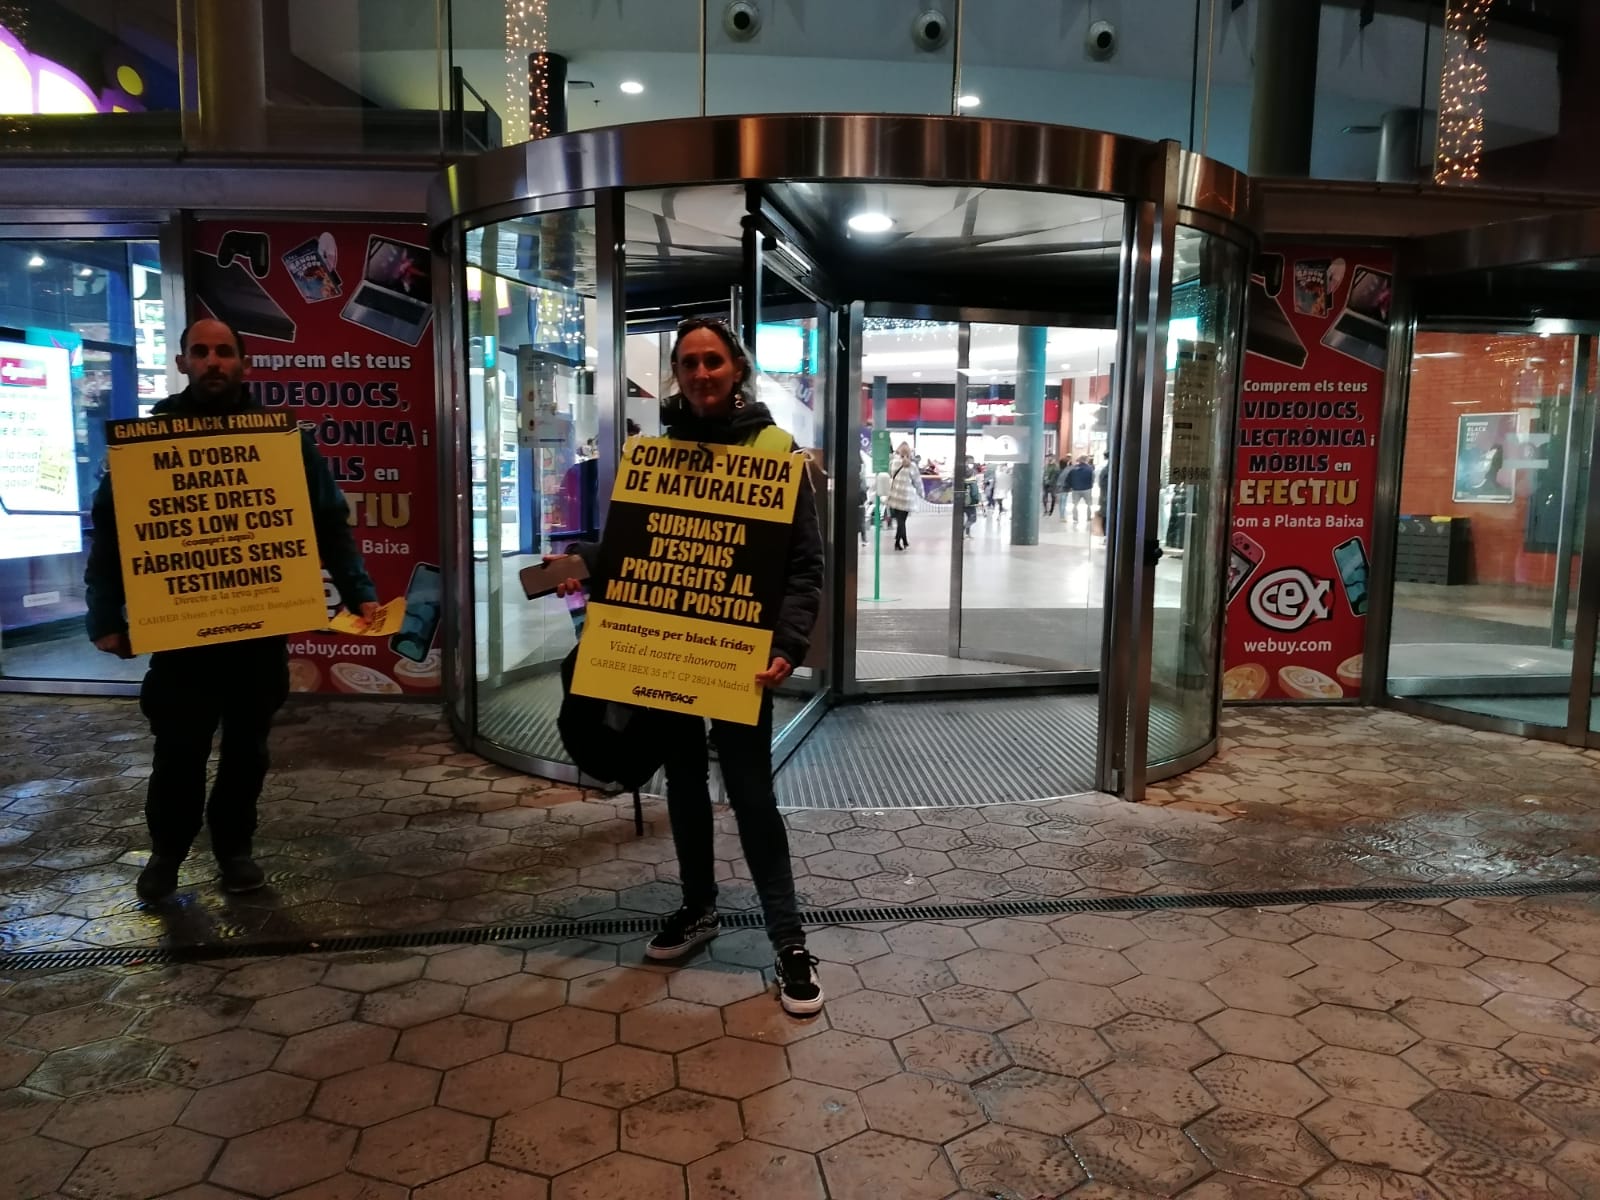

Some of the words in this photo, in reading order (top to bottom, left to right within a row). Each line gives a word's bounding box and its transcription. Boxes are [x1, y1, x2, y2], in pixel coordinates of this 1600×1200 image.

[244, 354, 326, 371] mprem
[332, 352, 361, 369] els
[366, 354, 411, 369] teus
[1244, 380, 1311, 394] Comprem
[1314, 380, 1335, 392] els
[1338, 381, 1368, 392] teus
[1244, 400, 1365, 422] VIDEOJOCS,
[115, 420, 168, 439] GANGA
[173, 416, 224, 433] BLACK
[229, 412, 289, 429] FRIDAY!
[1239, 425, 1367, 448] LECTRÒNICA
[154, 446, 184, 470] MÀ
[190, 445, 260, 467] D'OBRA
[631, 445, 791, 483] COMPRA-VENDA
[1248, 451, 1330, 474] MÒBILS
[1334, 461, 1351, 472] en
[173, 468, 248, 491] BARATA
[374, 467, 400, 481] en
[149, 493, 209, 517] SENSE
[216, 488, 276, 510] DRETS
[625, 469, 653, 492] DE
[656, 473, 784, 510] NATURALESA
[1239, 479, 1358, 505] EFECTIU
[134, 517, 192, 542] VIDES
[200, 514, 240, 534] LOW
[246, 508, 294, 530] COST
[646, 512, 747, 545] SUBHASTA
[1262, 517, 1270, 527] a
[1275, 515, 1321, 528] Planta
[1325, 515, 1364, 528] Baixa
[132, 546, 243, 576] FÀBRIQUES
[250, 539, 307, 562] SENSE
[362, 540, 410, 555] Baixa
[649, 537, 735, 569] D'ESPAIS
[165, 565, 283, 595] TESTIMONIS
[620, 557, 728, 593] PROTEGITS
[730, 574, 754, 597] AL
[605, 579, 678, 610] MILLOR
[682, 591, 763, 624] POSTOR
[196, 621, 264, 638] GREENPEACE
[599, 618, 660, 639] Avantatges
[663, 629, 683, 643] per
[686, 632, 718, 647] black
[720, 637, 756, 655] friday
[610, 640, 636, 655] Visiti
[639, 645, 648, 656] el
[650, 649, 682, 663] nostre
[684, 652, 737, 671] showroom
[1244, 638, 1332, 655] webuy.com
[590, 657, 626, 671] CARRER
[628, 664, 650, 677] IBEX
[650, 666, 661, 677] 35
[677, 672, 691, 683] CP
[692, 674, 717, 687] 28014
[718, 678, 750, 693] Madrid
[632, 686, 698, 705] GREENPEACE
